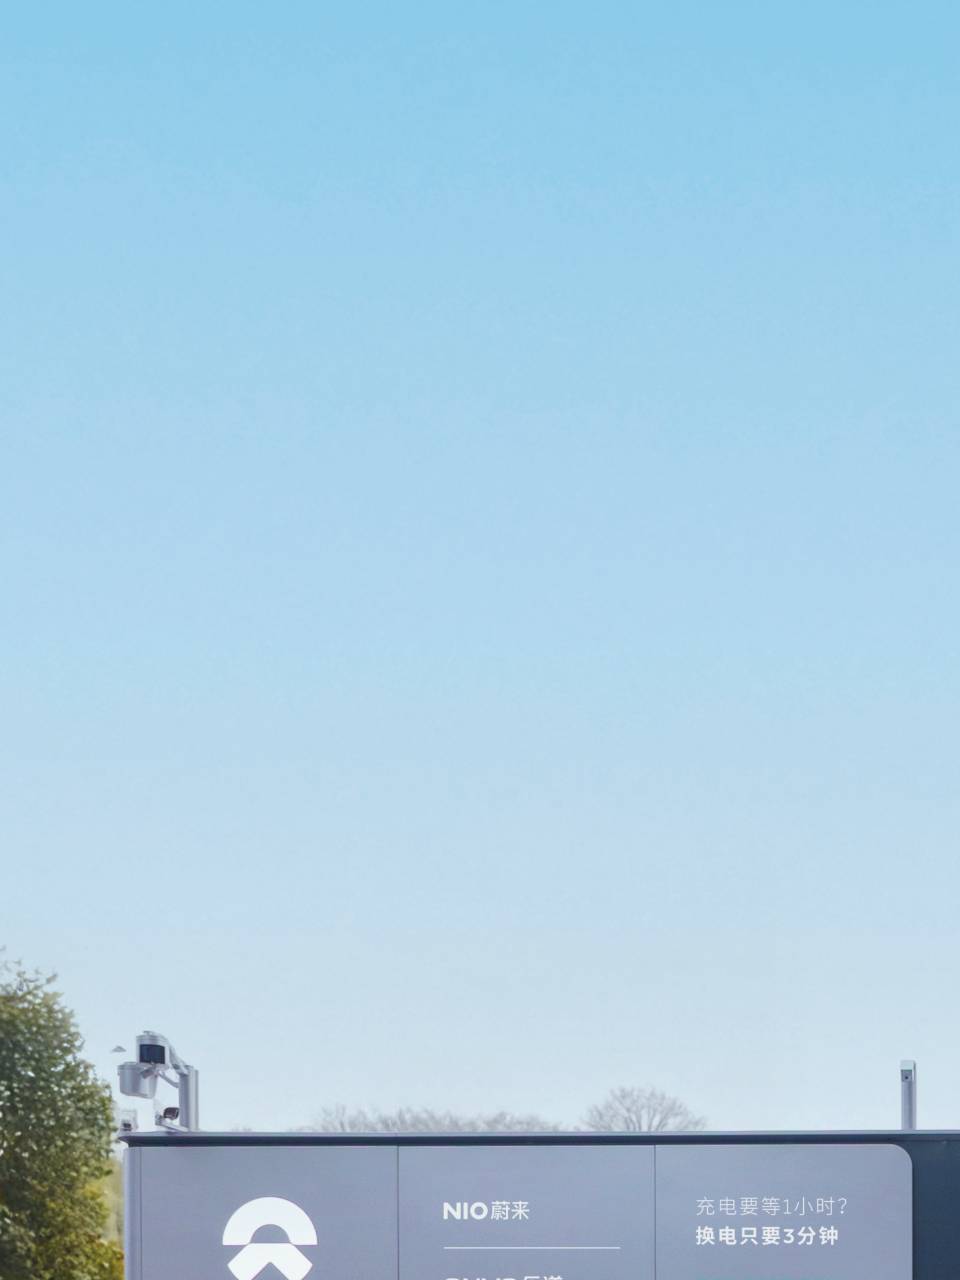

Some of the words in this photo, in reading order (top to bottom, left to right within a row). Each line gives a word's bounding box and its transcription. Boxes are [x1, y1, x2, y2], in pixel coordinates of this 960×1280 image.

[695, 1225, 839, 1246] 换电只要3分钟
